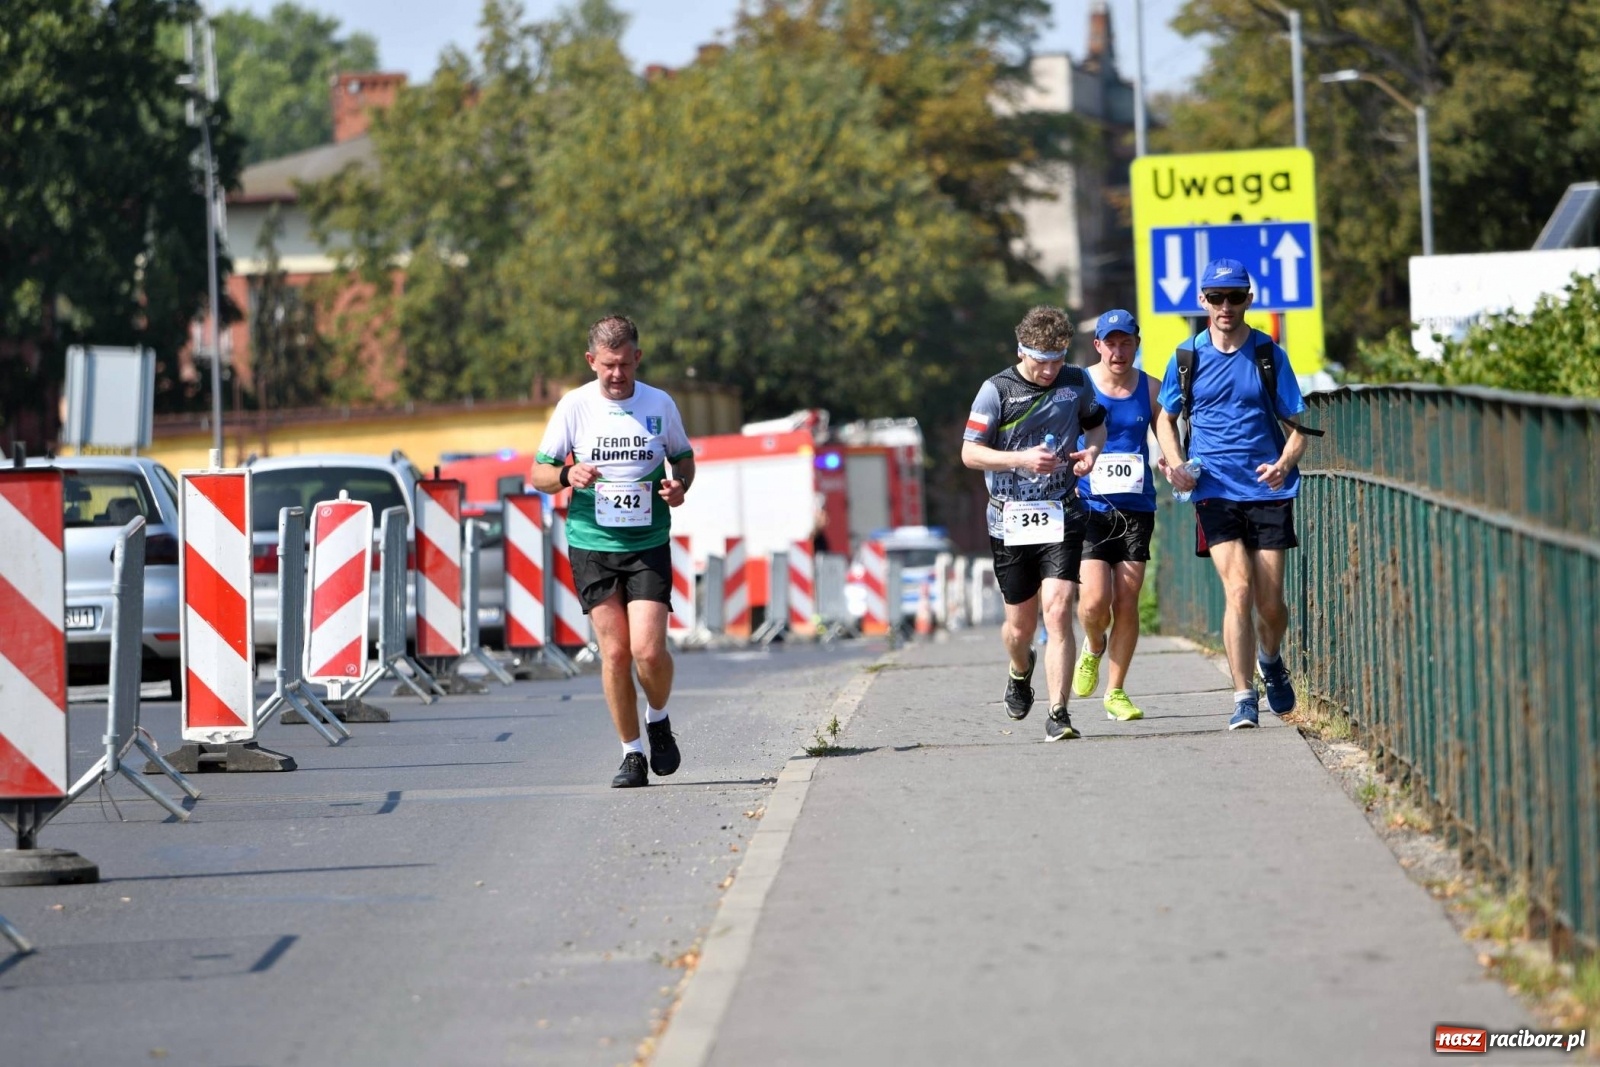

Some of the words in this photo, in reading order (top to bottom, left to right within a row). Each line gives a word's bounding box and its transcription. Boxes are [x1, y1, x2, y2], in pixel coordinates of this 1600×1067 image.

[1152, 168, 1292, 204] Uwaga
[596, 436, 630, 448] TEAM
[633, 435, 648, 448] OF
[1107, 464, 1132, 478] 500
[613, 494, 641, 509] 242
[1022, 512, 1049, 527] 343
